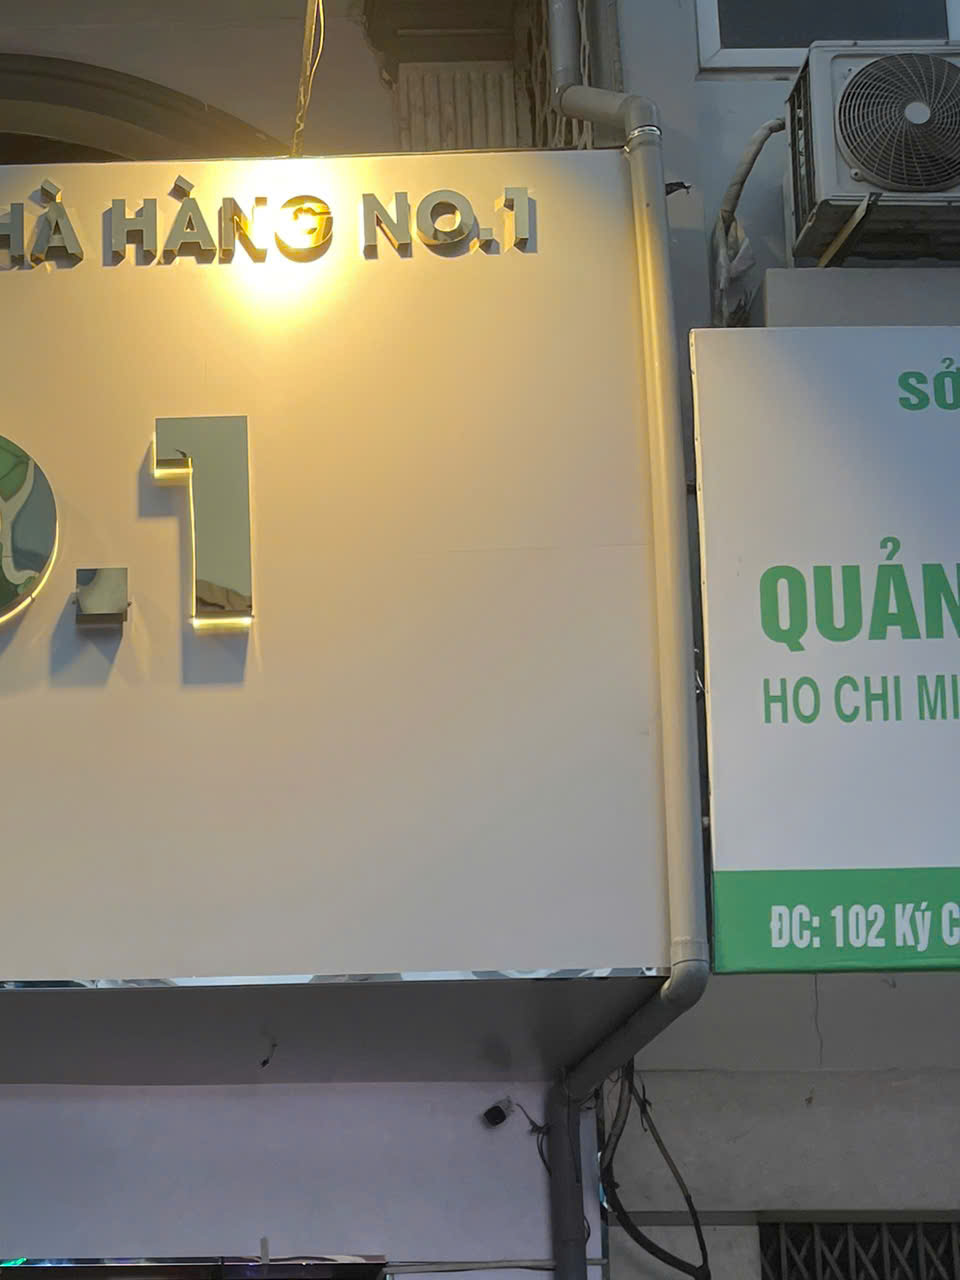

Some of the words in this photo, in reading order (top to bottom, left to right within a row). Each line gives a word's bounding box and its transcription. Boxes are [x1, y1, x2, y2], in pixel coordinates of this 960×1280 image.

[108, 174, 333, 264] HÀNG
[362, 187, 530, 258] NO.1
[763, 676, 820, 724] HO
[834, 675, 902, 722] CHI
[770, 904, 820, 948] ĐC:
[831, 904, 886, 948] 102
[895, 901, 932, 951] Ký
